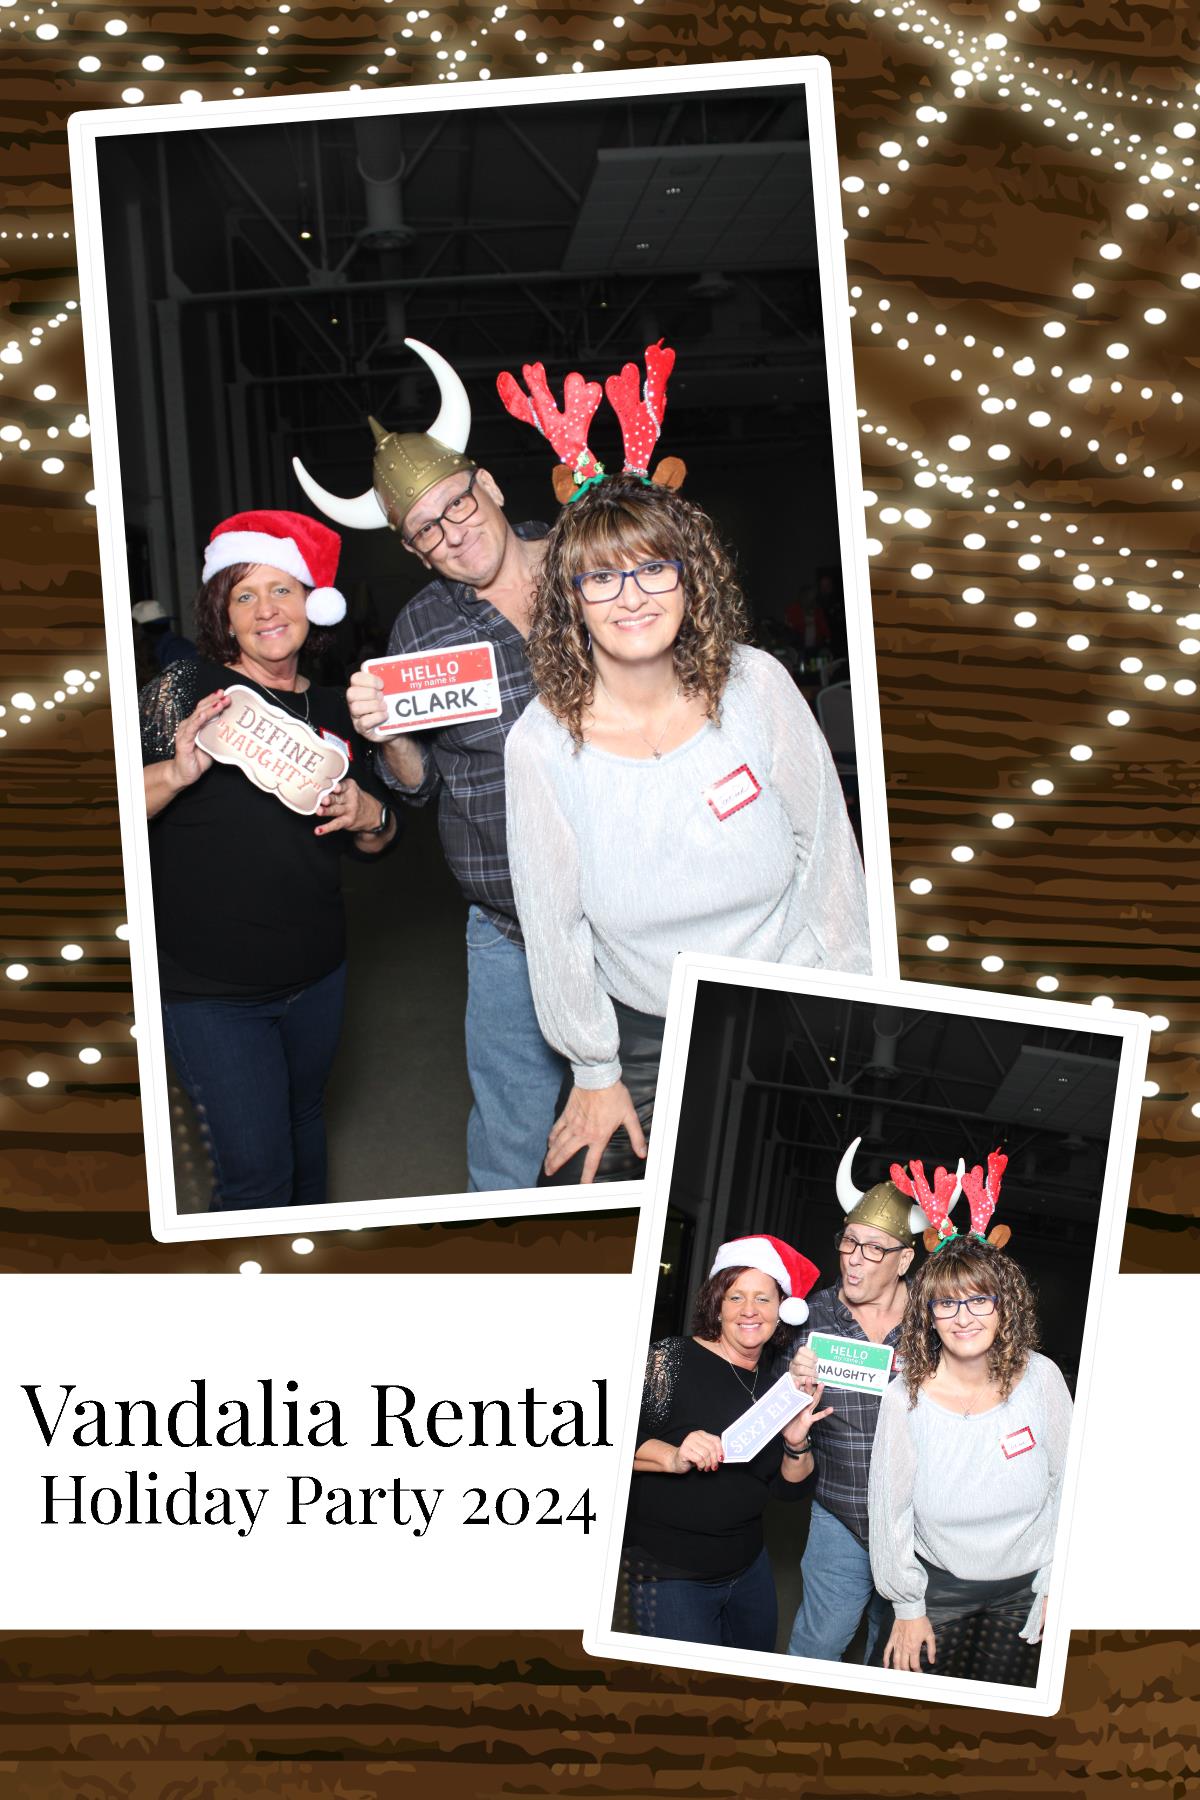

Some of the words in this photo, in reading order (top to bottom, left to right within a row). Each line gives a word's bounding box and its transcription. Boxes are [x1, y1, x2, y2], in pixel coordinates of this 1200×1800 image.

[401, 661, 459, 682] HELLO
[410, 681, 422, 689] my
[424, 678, 447, 687] name
[449, 676, 457, 684] is
[395, 687, 478, 717] CLARK
[236, 705, 325, 774] DEFINE
[830, 1345, 868, 1360] HELLO
[817, 1364, 876, 1383] NAUGHTY
[729, 1415, 766, 1454] SEXY
[766, 1391, 792, 1420] ELF
